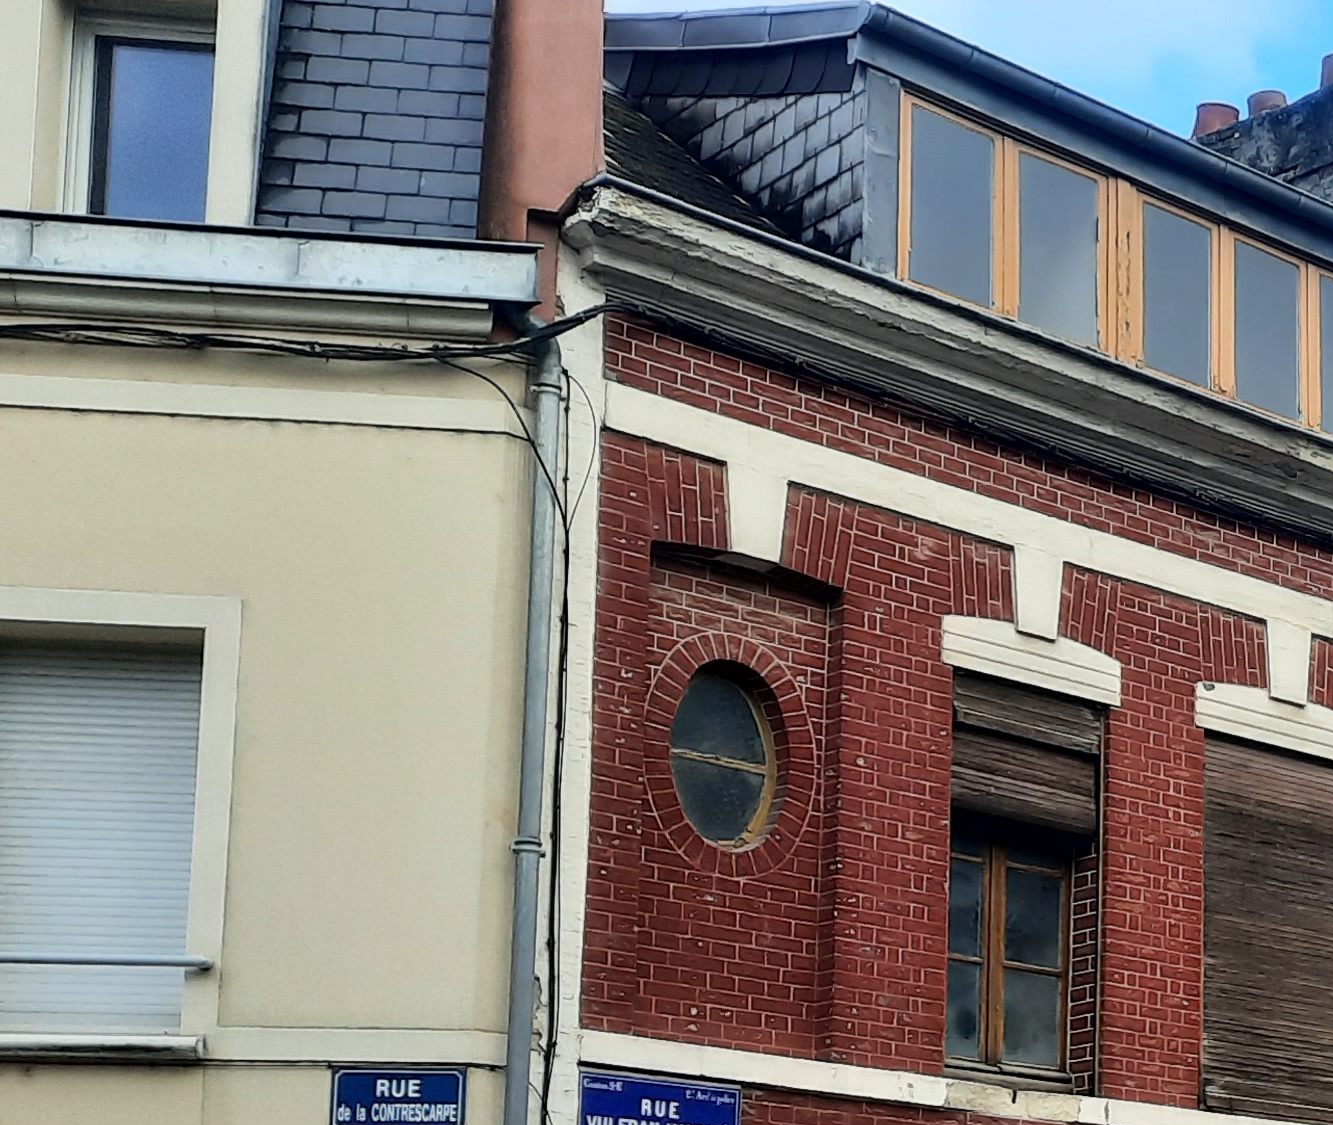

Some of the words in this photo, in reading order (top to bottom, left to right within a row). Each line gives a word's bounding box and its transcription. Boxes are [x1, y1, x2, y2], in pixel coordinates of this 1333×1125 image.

[375, 1079, 421, 1098] RUE
[337, 1103, 352, 1121] de
[356, 1103, 366, 1121] la
[371, 1103, 457, 1122] CONTRESCARPE
[641, 1098, 680, 1119] RUE
